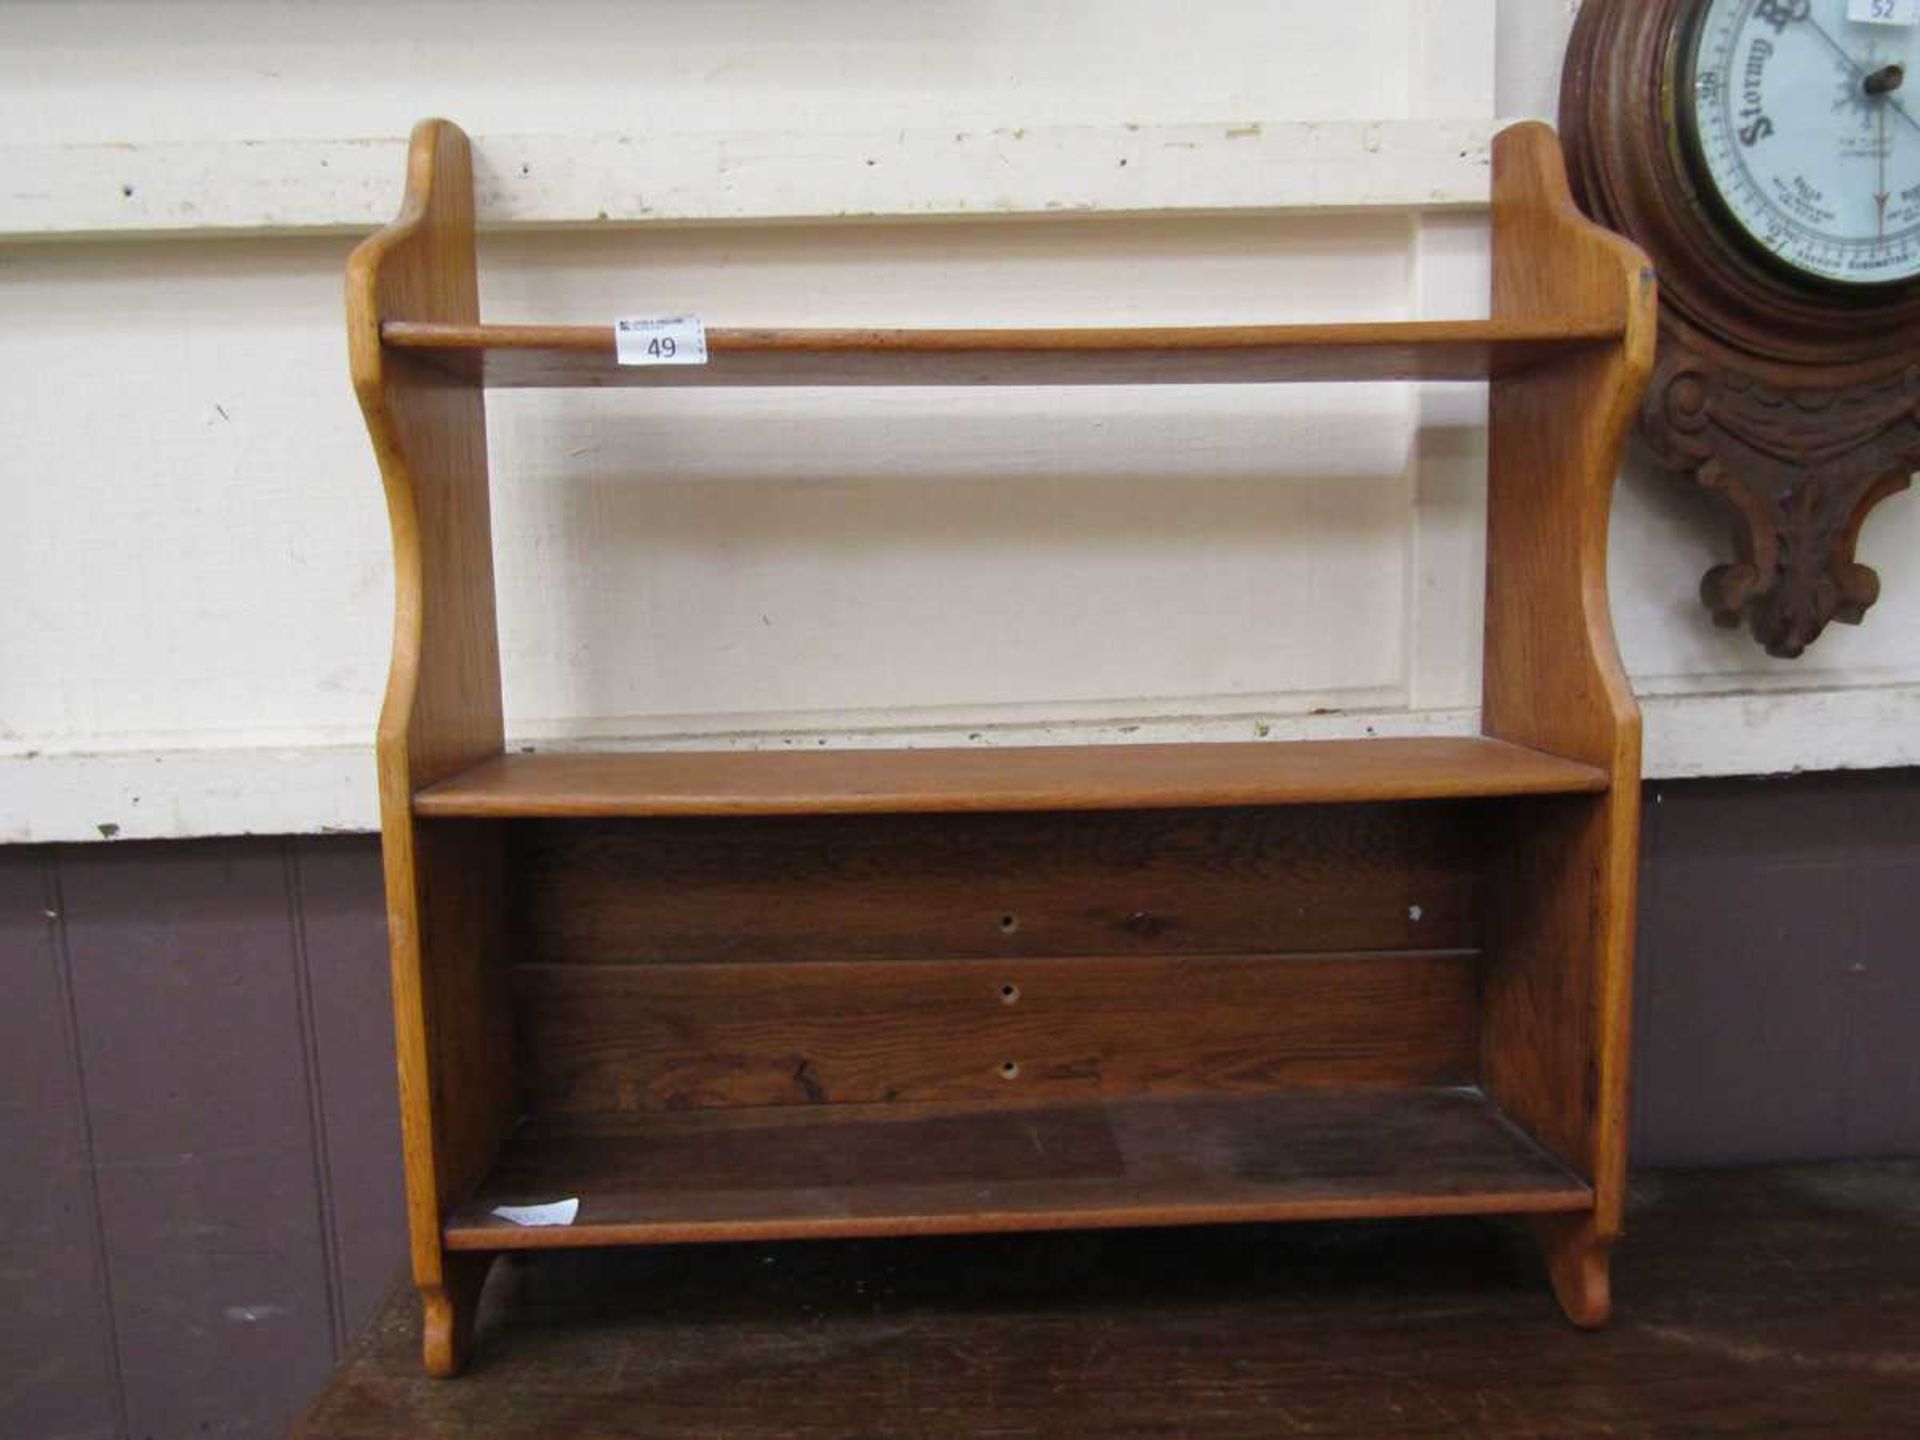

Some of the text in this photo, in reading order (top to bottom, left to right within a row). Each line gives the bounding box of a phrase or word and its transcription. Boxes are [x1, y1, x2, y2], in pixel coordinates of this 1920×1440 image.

[1871, 0, 1894, 18] 52
[1739, 37, 1774, 147] Stormy
[647, 336, 676, 359] 49
